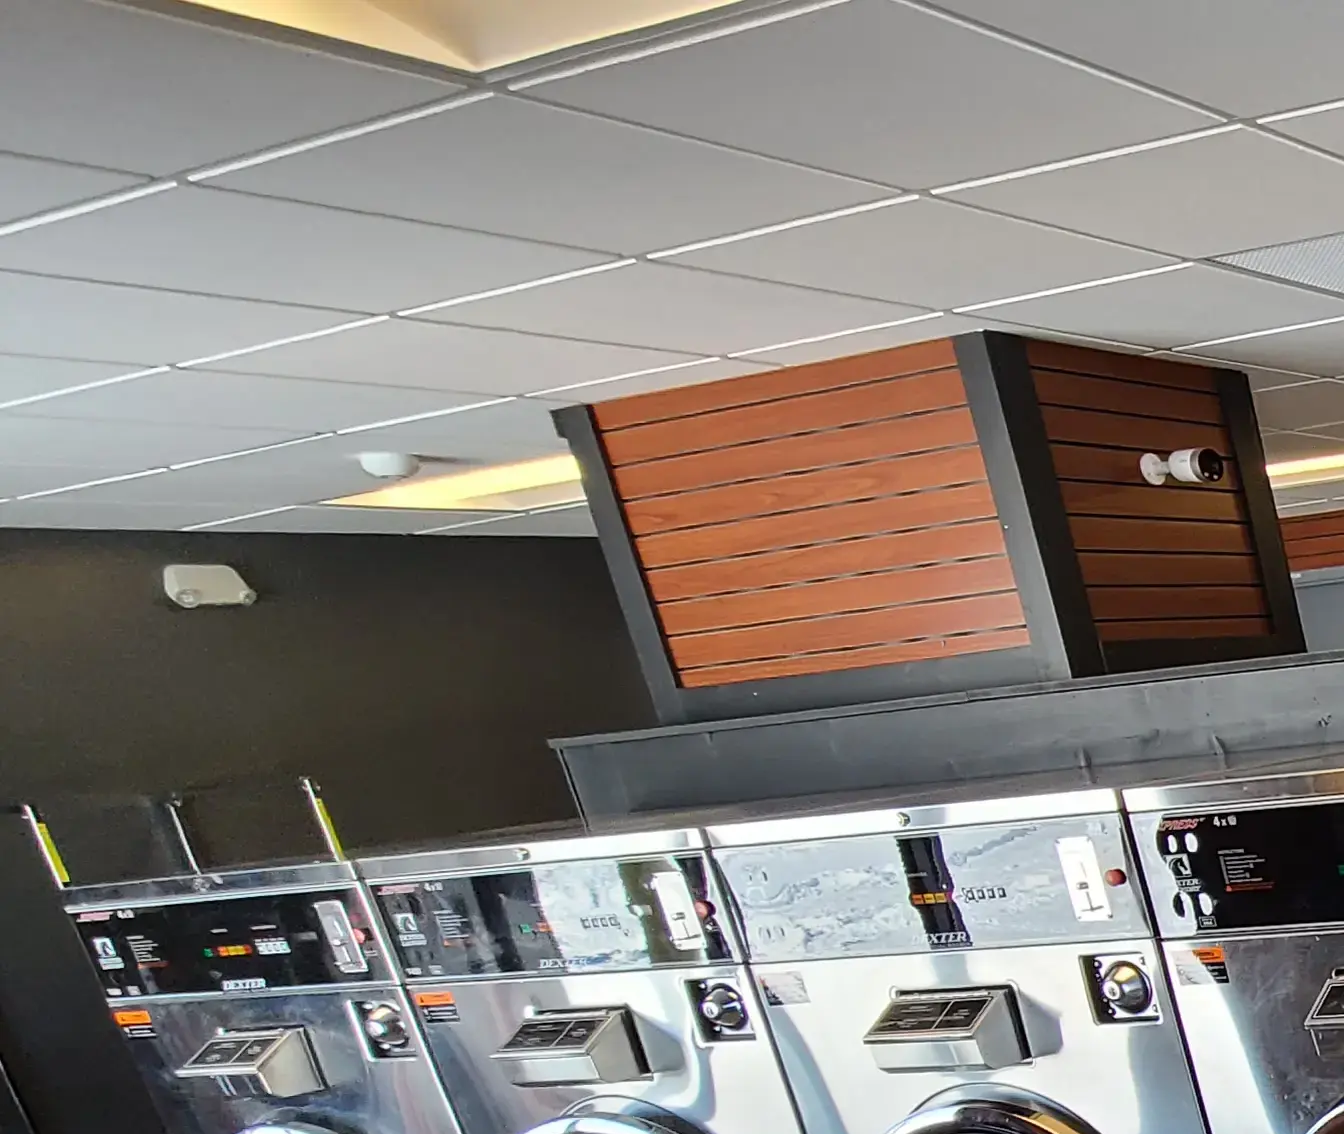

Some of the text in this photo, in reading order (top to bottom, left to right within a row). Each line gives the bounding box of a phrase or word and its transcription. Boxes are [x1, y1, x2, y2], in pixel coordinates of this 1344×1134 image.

[1160, 818, 1199, 831] XPRESS
[1213, 816, 1220, 827] 4
[222, 978, 265, 990] DEXTER
